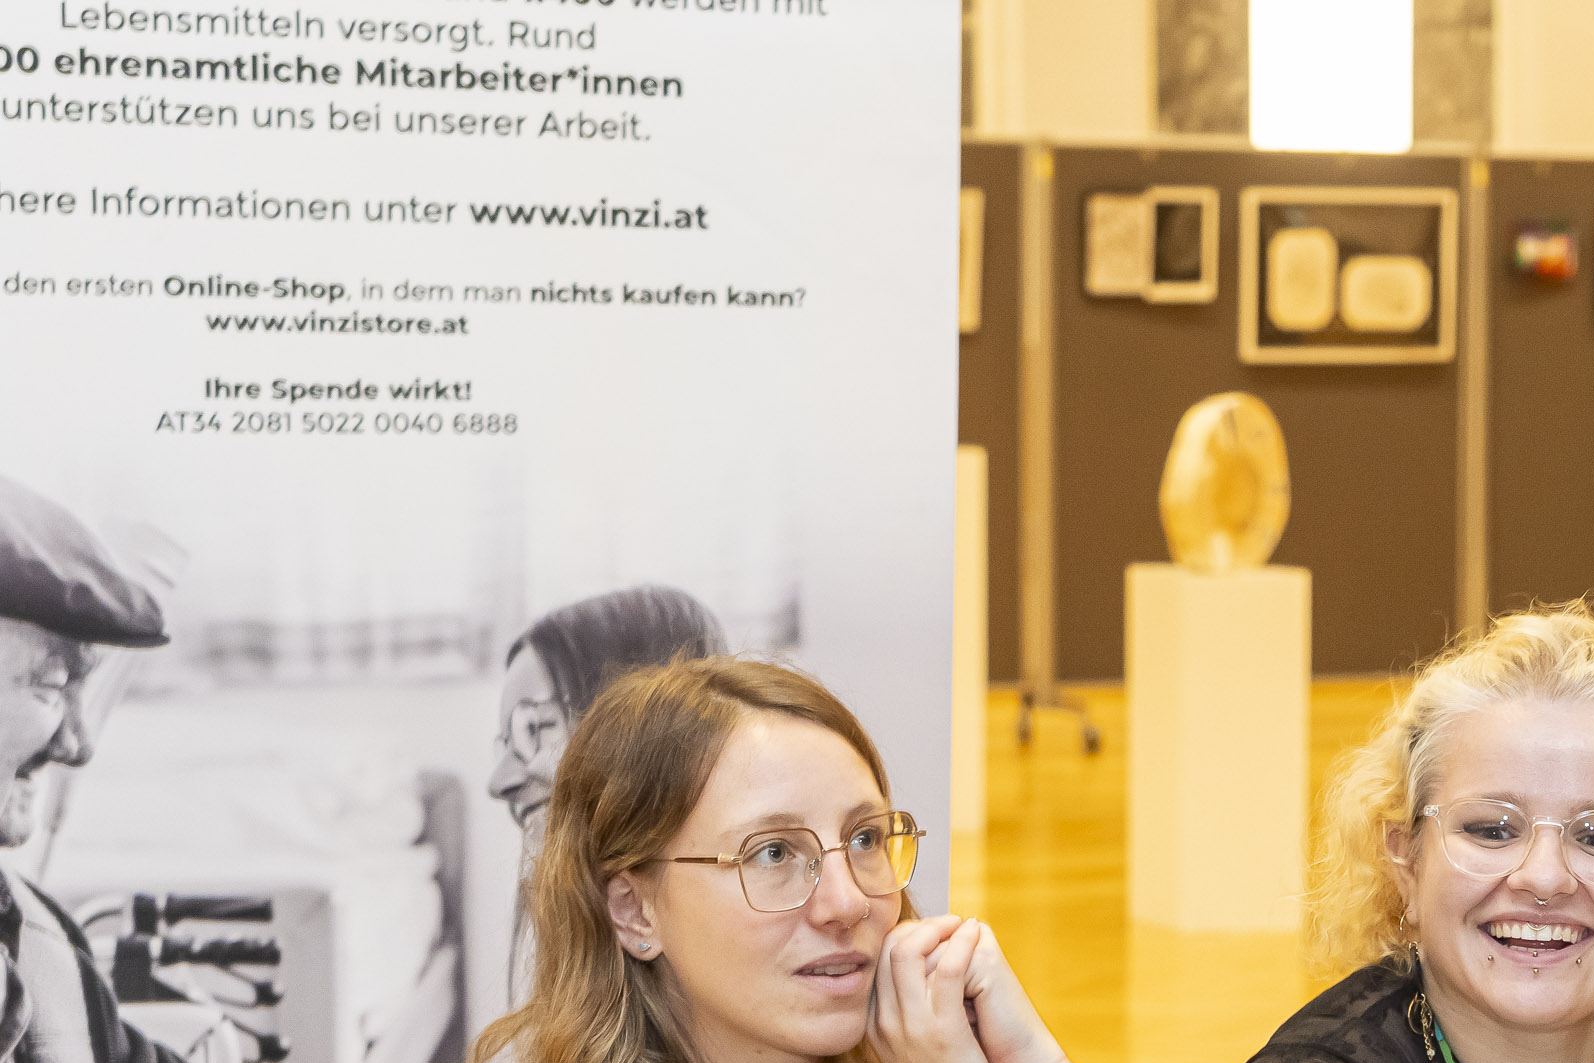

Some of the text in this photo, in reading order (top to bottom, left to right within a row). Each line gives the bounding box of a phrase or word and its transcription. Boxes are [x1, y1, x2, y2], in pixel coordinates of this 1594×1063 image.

[60, 0, 596, 53] Lebensmitteln versorgt. Rund
[54, 46, 342, 85] ehrenamtliche
[2, 93, 650, 141] unterstützen uns bei unserer Arbeit.
[91, 185, 350, 221] Informationen
[364, 196, 457, 224] unter
[468, 197, 709, 231] www.vinzi.at
[3, 272, 806, 307] den ersten Online-Shop, in dem man nichts kaufen kann?
[206, 310, 469, 335] www.vinzistore.at
[205, 377, 471, 405] Ihre Spende wirkt!
[156, 411, 518, 435] AT34 2081 5022 0040 6888
